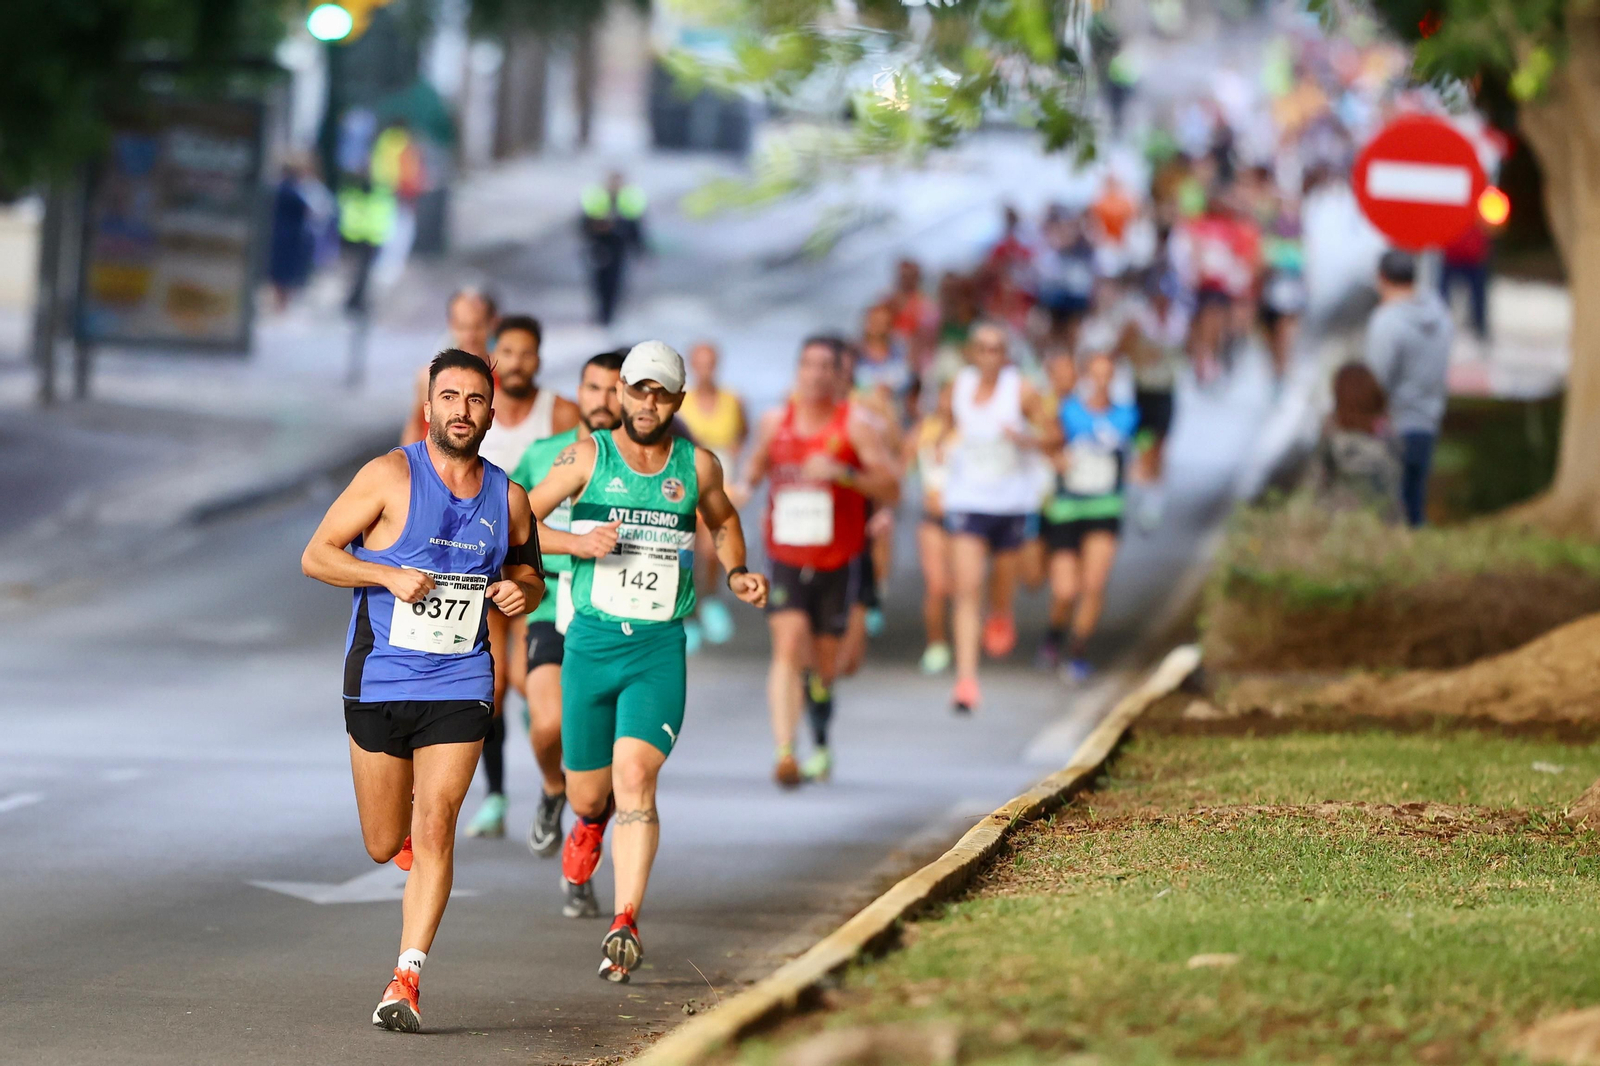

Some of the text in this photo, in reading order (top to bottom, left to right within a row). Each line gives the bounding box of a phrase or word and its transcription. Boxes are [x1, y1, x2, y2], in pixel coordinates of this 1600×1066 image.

[608, 508, 679, 527] ATLETISMO
[429, 537, 478, 551] RETROGUSTO
[619, 569, 658, 591] 142
[412, 596, 470, 621] 6377
